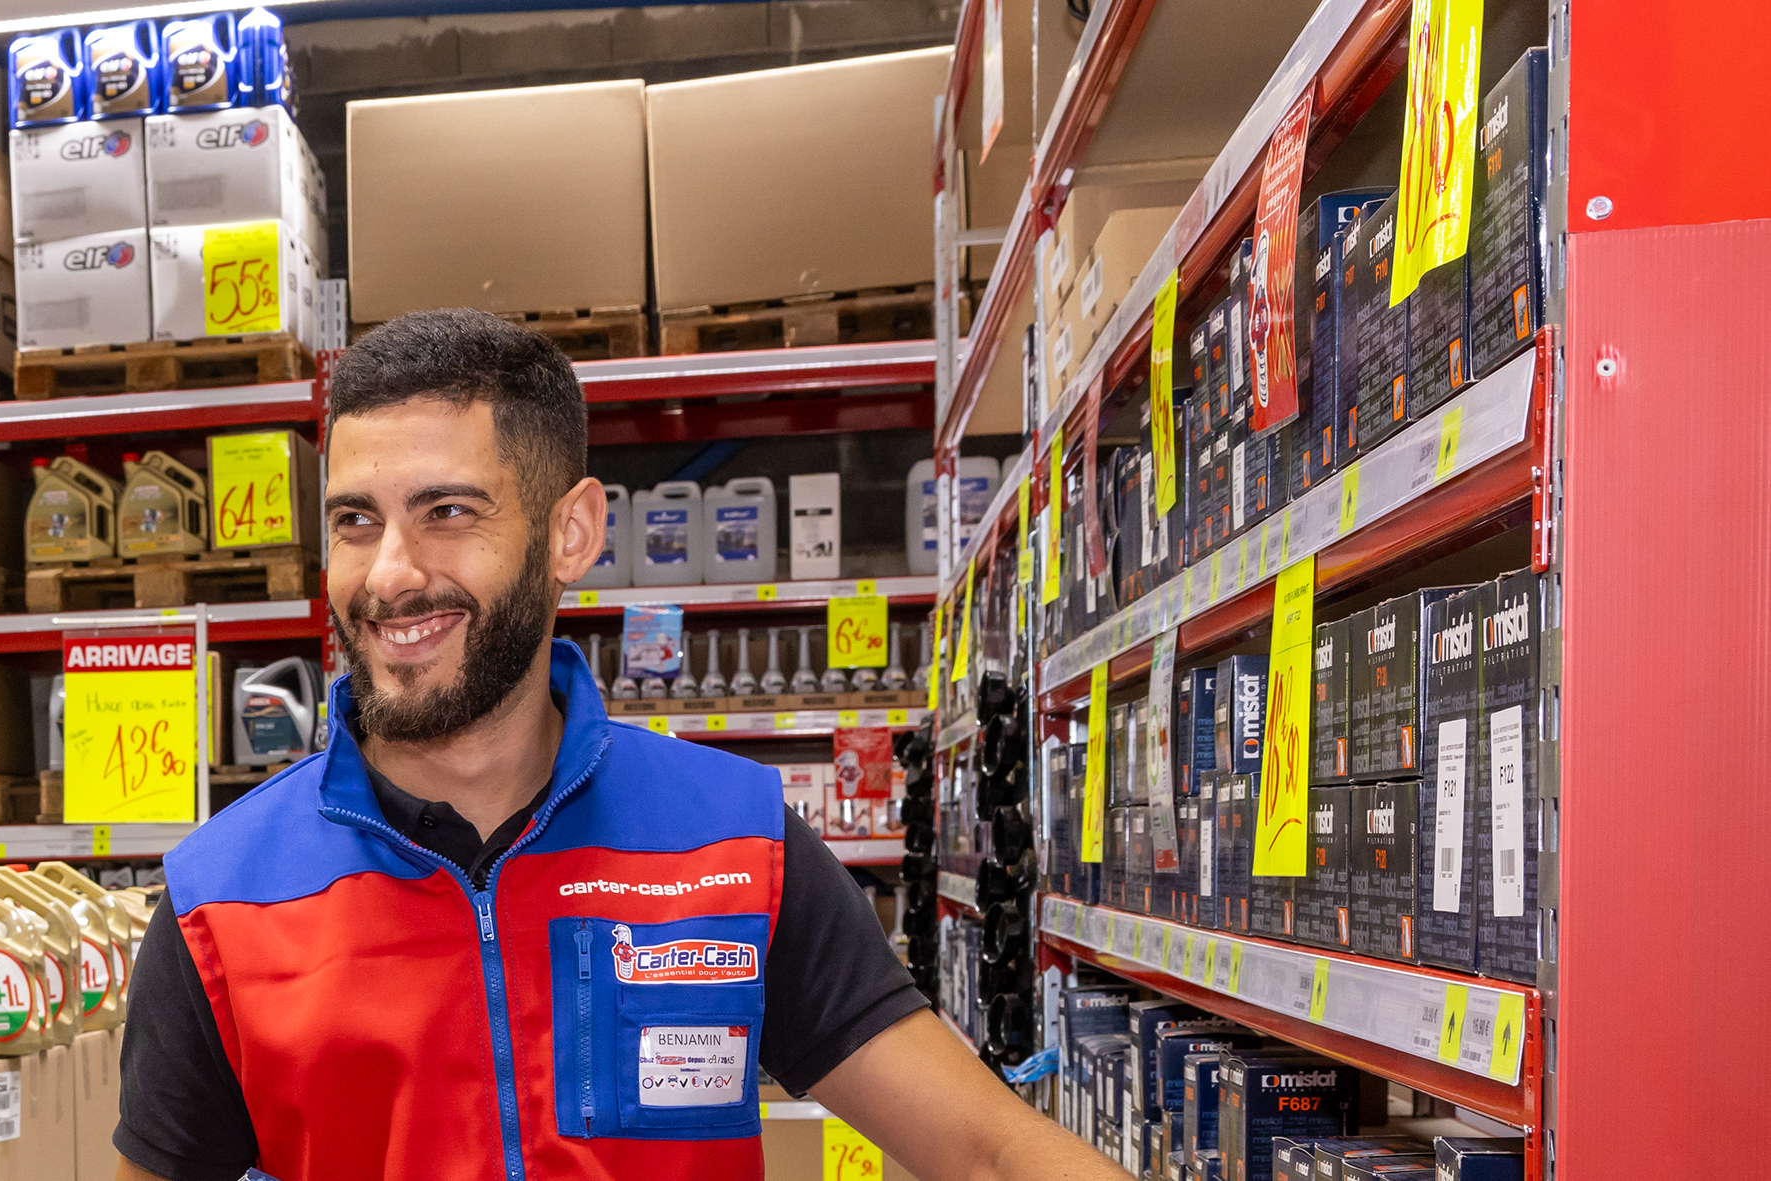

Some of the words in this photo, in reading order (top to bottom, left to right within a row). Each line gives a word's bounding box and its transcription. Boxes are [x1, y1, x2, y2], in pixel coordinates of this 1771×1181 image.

[197, 124, 243, 149] elf
[61, 138, 108, 161] elf
[64, 246, 109, 271] elf
[1493, 592, 1529, 649] misfat
[1442, 612, 1473, 661] misfat
[67, 643, 192, 668] ARRIVAGE
[1239, 673, 1260, 737] misfat
[1499, 764, 1515, 785] F122
[1444, 780, 1457, 798] F121
[559, 872, 751, 896] carter-cash.com
[637, 946, 751, 970] Carter-Cash
[645, 969, 695, 978] L'essentiel
[658, 1034, 722, 1046] BENJAMIN
[1280, 1069, 1337, 1088] misfat
[1278, 1096, 1321, 1112] F687
